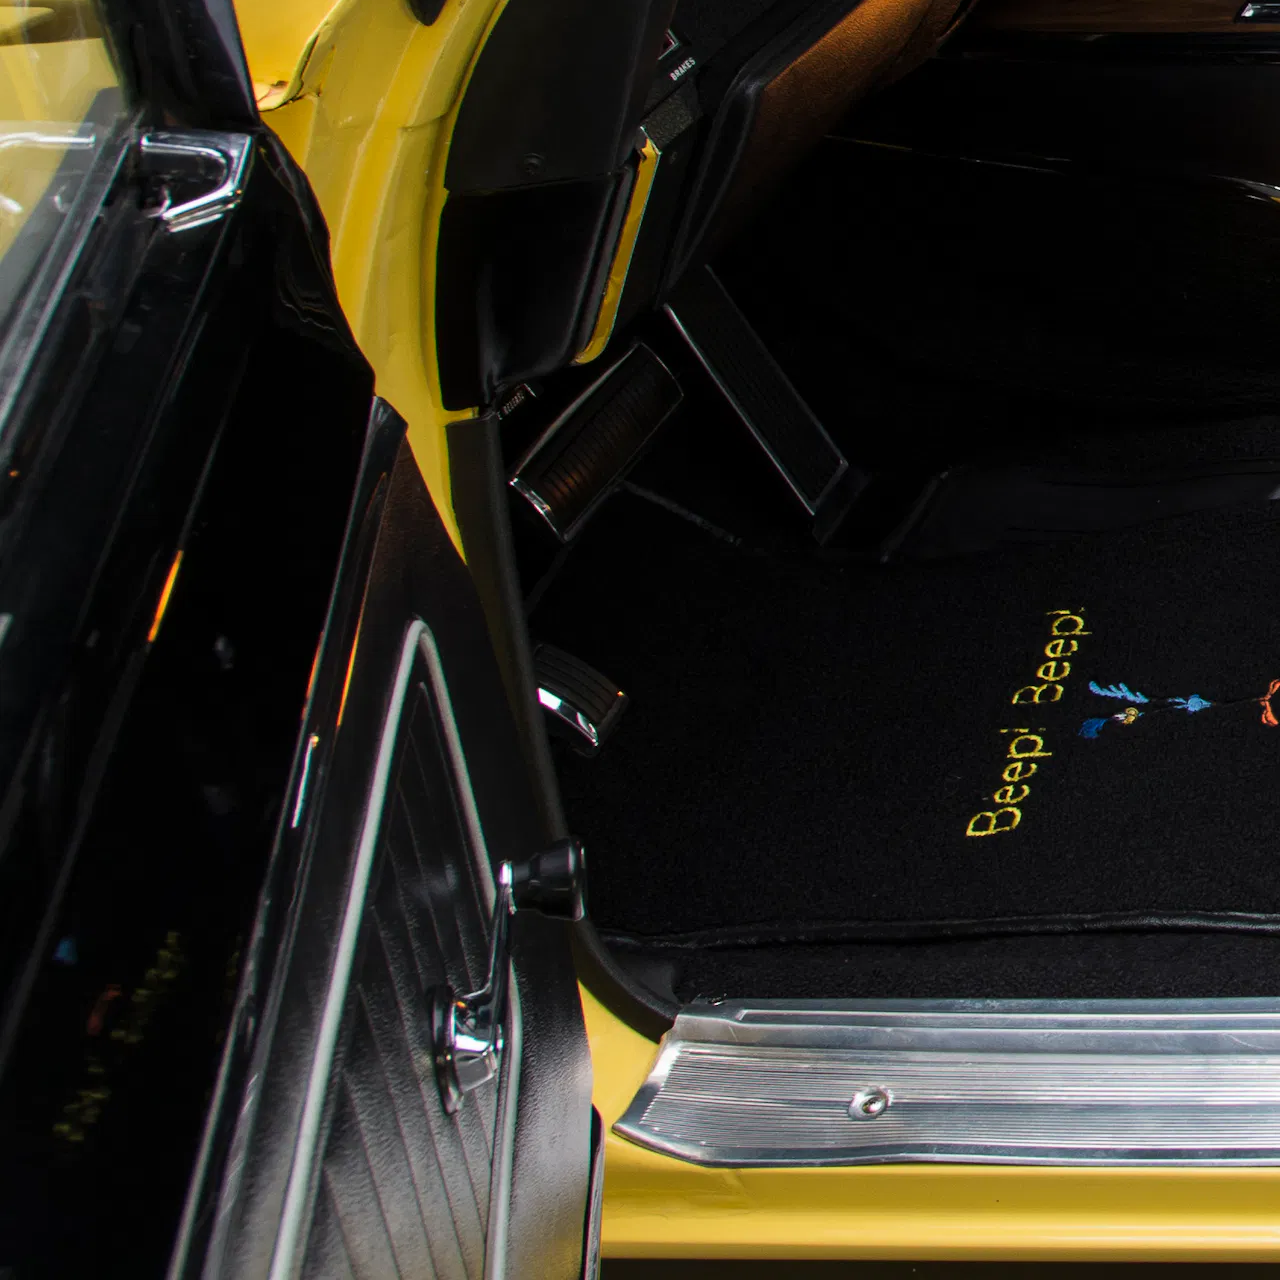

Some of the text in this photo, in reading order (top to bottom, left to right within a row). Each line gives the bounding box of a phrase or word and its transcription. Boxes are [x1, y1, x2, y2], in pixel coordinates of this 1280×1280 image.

[669, 56, 697, 81] BRAKES
[965, 606, 1092, 837] Beep! Beep!
